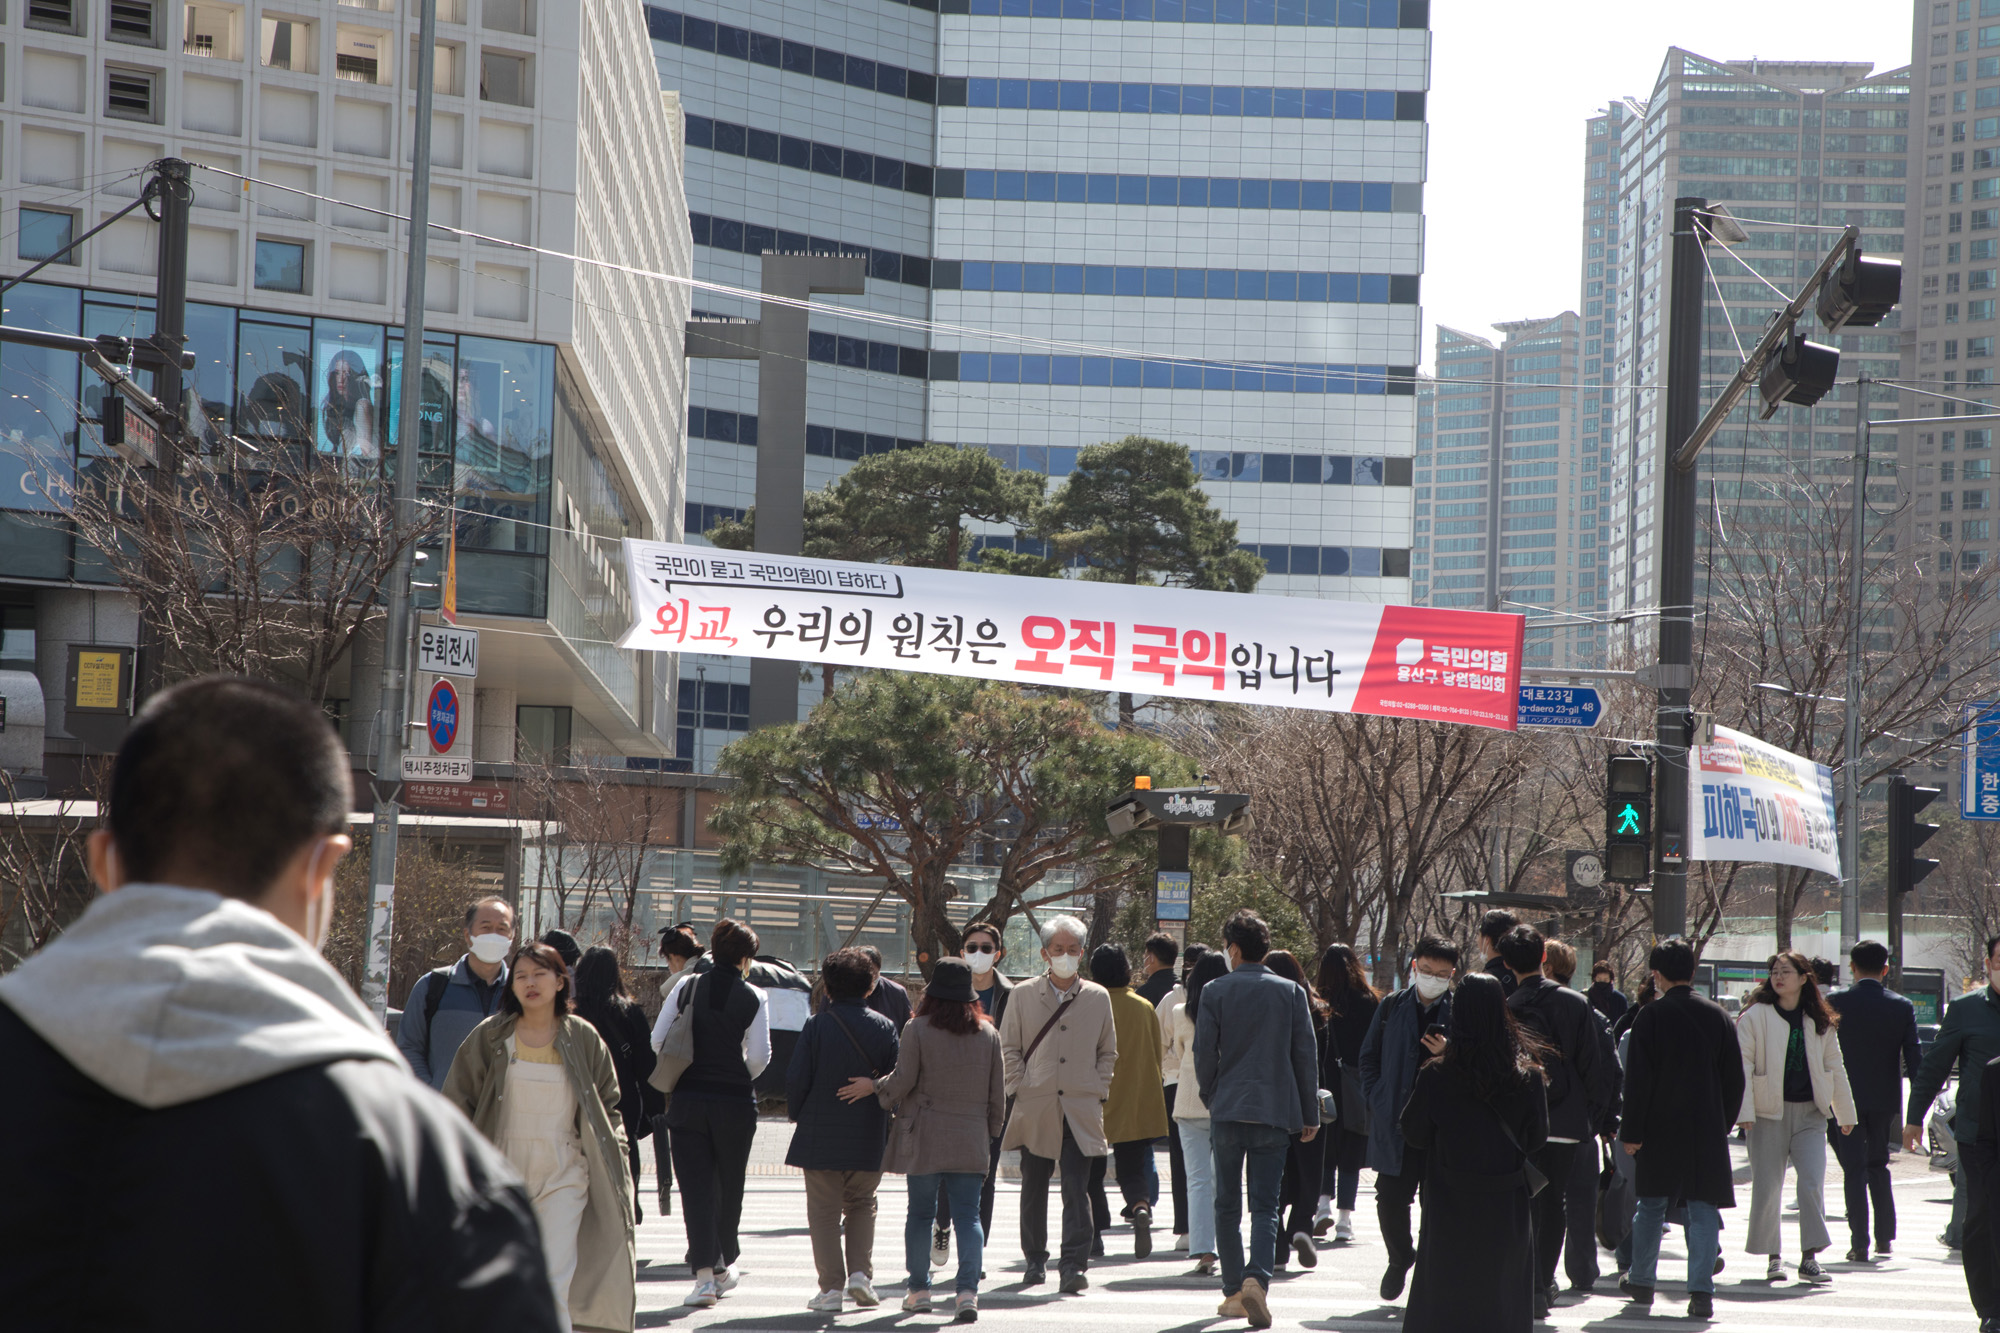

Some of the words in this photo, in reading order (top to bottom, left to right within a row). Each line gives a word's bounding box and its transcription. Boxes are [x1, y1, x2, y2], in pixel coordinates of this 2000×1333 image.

[655, 555, 707, 577] 국민이
[711, 559, 745, 581] 묻고
[749, 564, 832, 586] 국민의힘이
[836, 571, 887, 590] 답하다
[421, 632, 475, 669] 우회전시
[650, 598, 738, 648] 외교,
[752, 604, 872, 656] 우리의
[887, 612, 1006, 664] 원칙은
[1014, 615, 1116, 681] 오직
[1132, 624, 1341, 698] 국익입니다
[1430, 645, 1508, 673] 국민의힘
[1397, 666, 1438, 684] 용산구
[1442, 671, 1506, 693] 당원협의회
[1519, 688, 1573, 703] 대로23길
[432, 709, 455, 725] 주정차금지
[1556, 705, 1579, 716] 23-gil
[1582, 702, 1594, 712] 48
[404, 760, 470, 777] 택시주정차금지
[1702, 783, 1770, 843] 피해국이
[1577, 863, 1600, 872] TAXI
